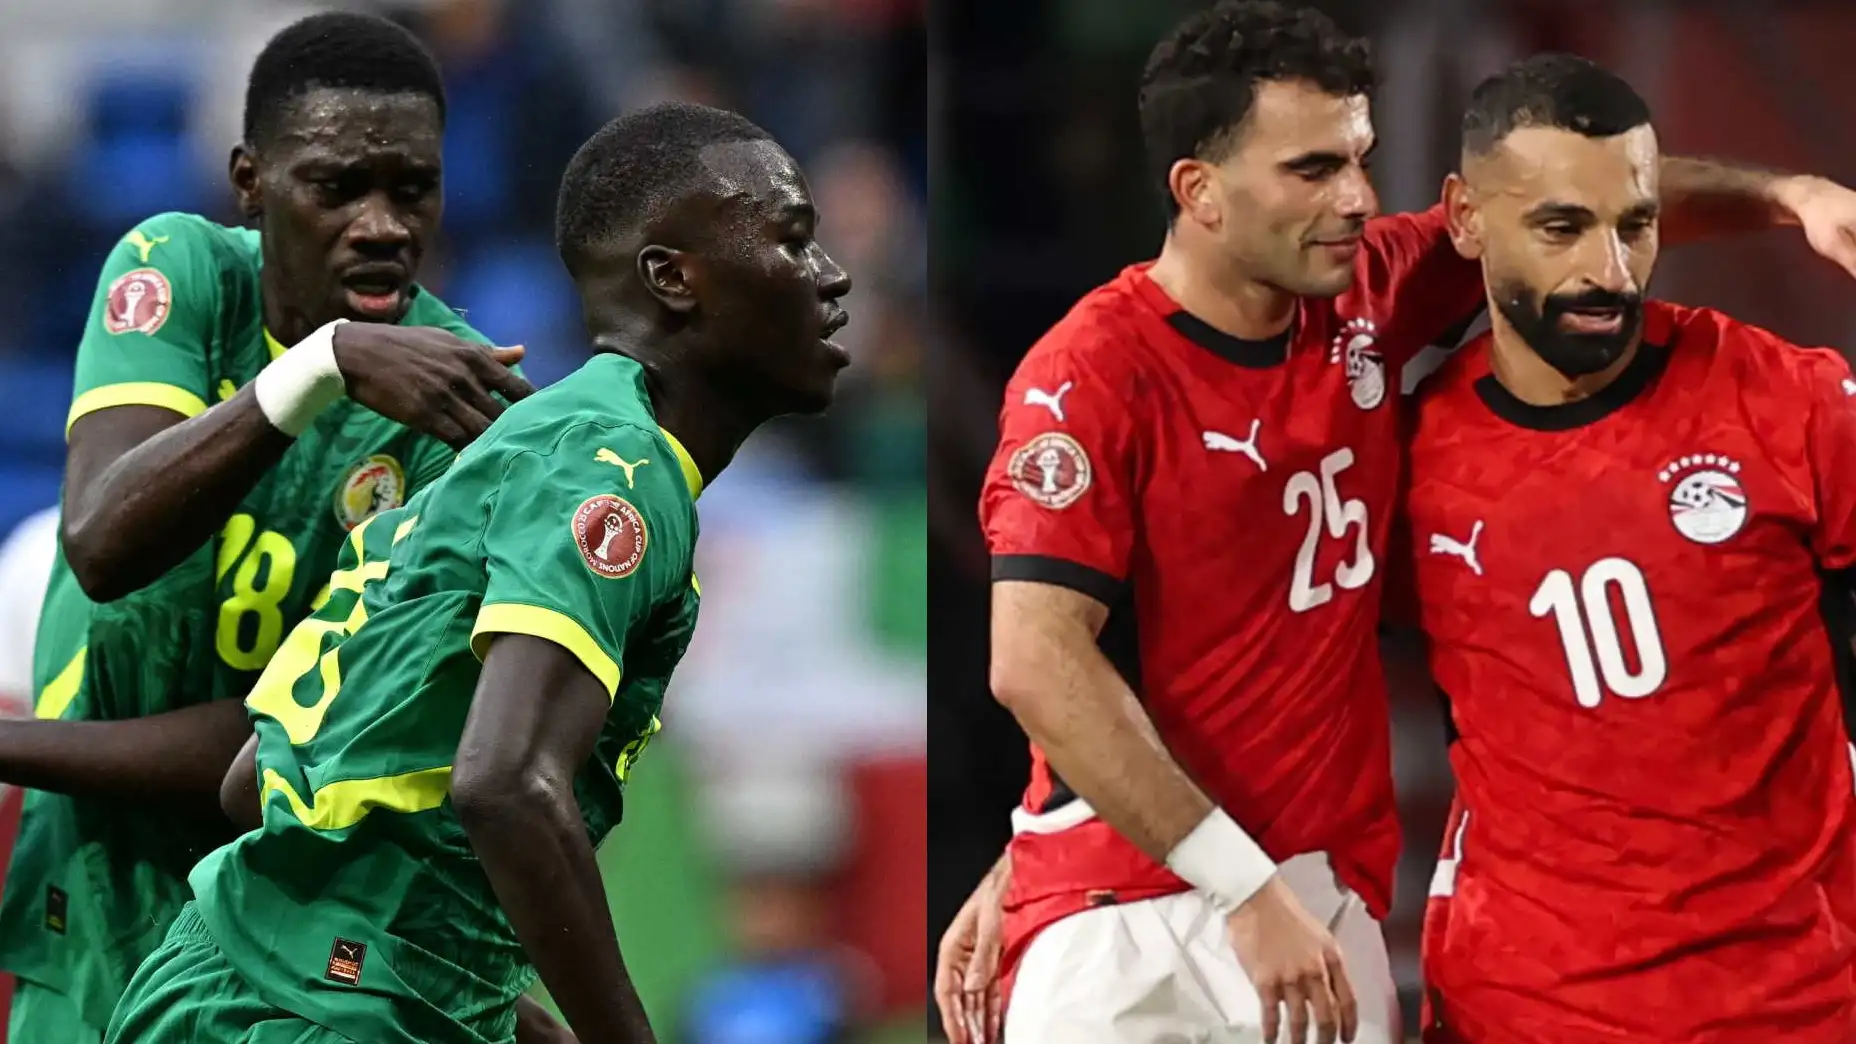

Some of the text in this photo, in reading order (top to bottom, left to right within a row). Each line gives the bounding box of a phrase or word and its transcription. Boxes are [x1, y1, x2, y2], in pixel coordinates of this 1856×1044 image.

[215, 513, 297, 671] 18
[598, 506, 643, 573] AFRICA CUP OF NATIONS
[1283, 447, 1375, 613] 25
[1529, 557, 1667, 709] 10
